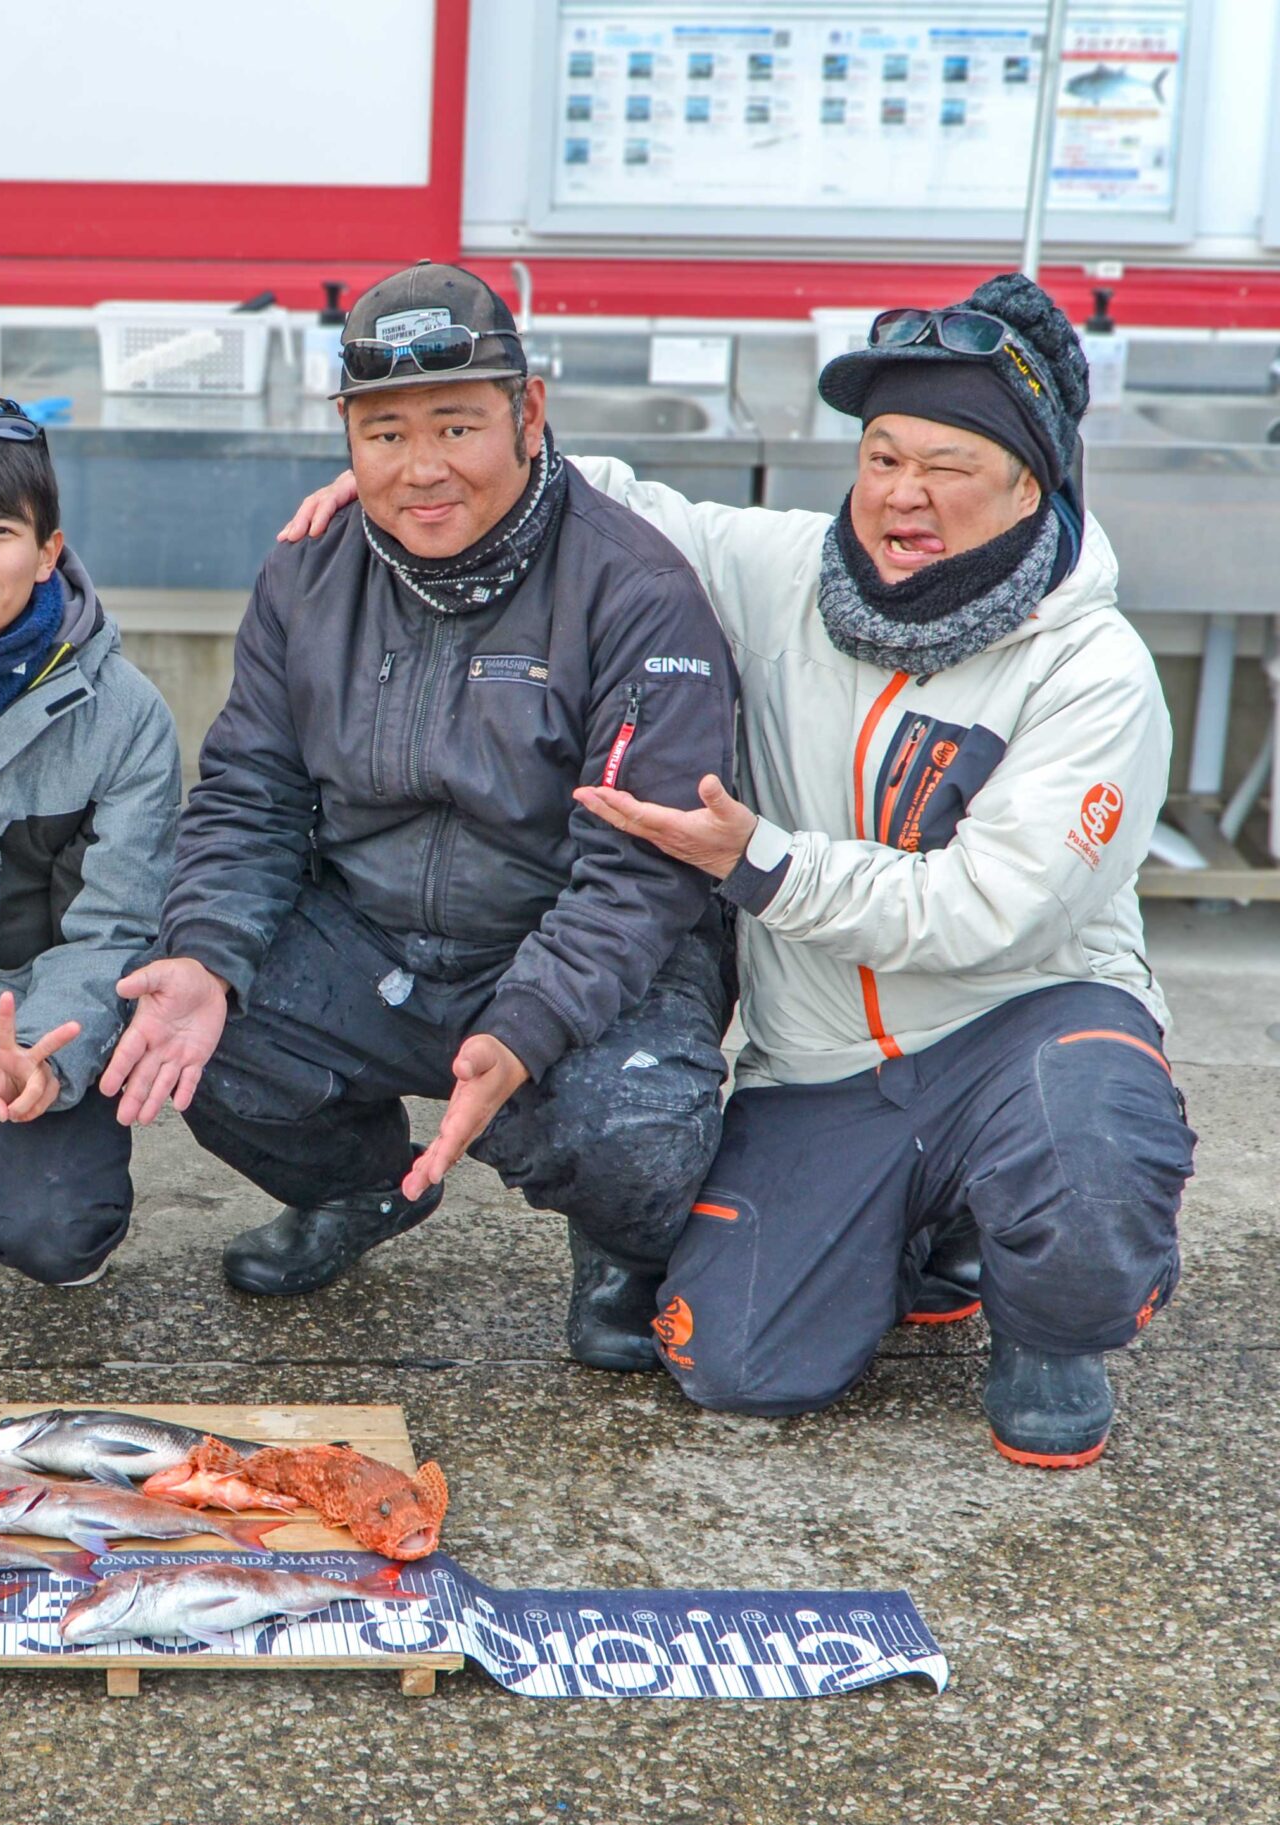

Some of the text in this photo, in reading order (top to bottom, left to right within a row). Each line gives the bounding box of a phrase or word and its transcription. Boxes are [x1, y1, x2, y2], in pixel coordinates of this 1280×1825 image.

[381, 324, 406, 335] FISHING
[644, 656, 711, 676] GINNIE
[93, 1555, 359, 1566] ONAN SUNNY SIDE MARINA
[636, 1612, 653, 1620] 105
[744, 1612, 762, 1620] 115
[359, 1599, 449, 1654] 8
